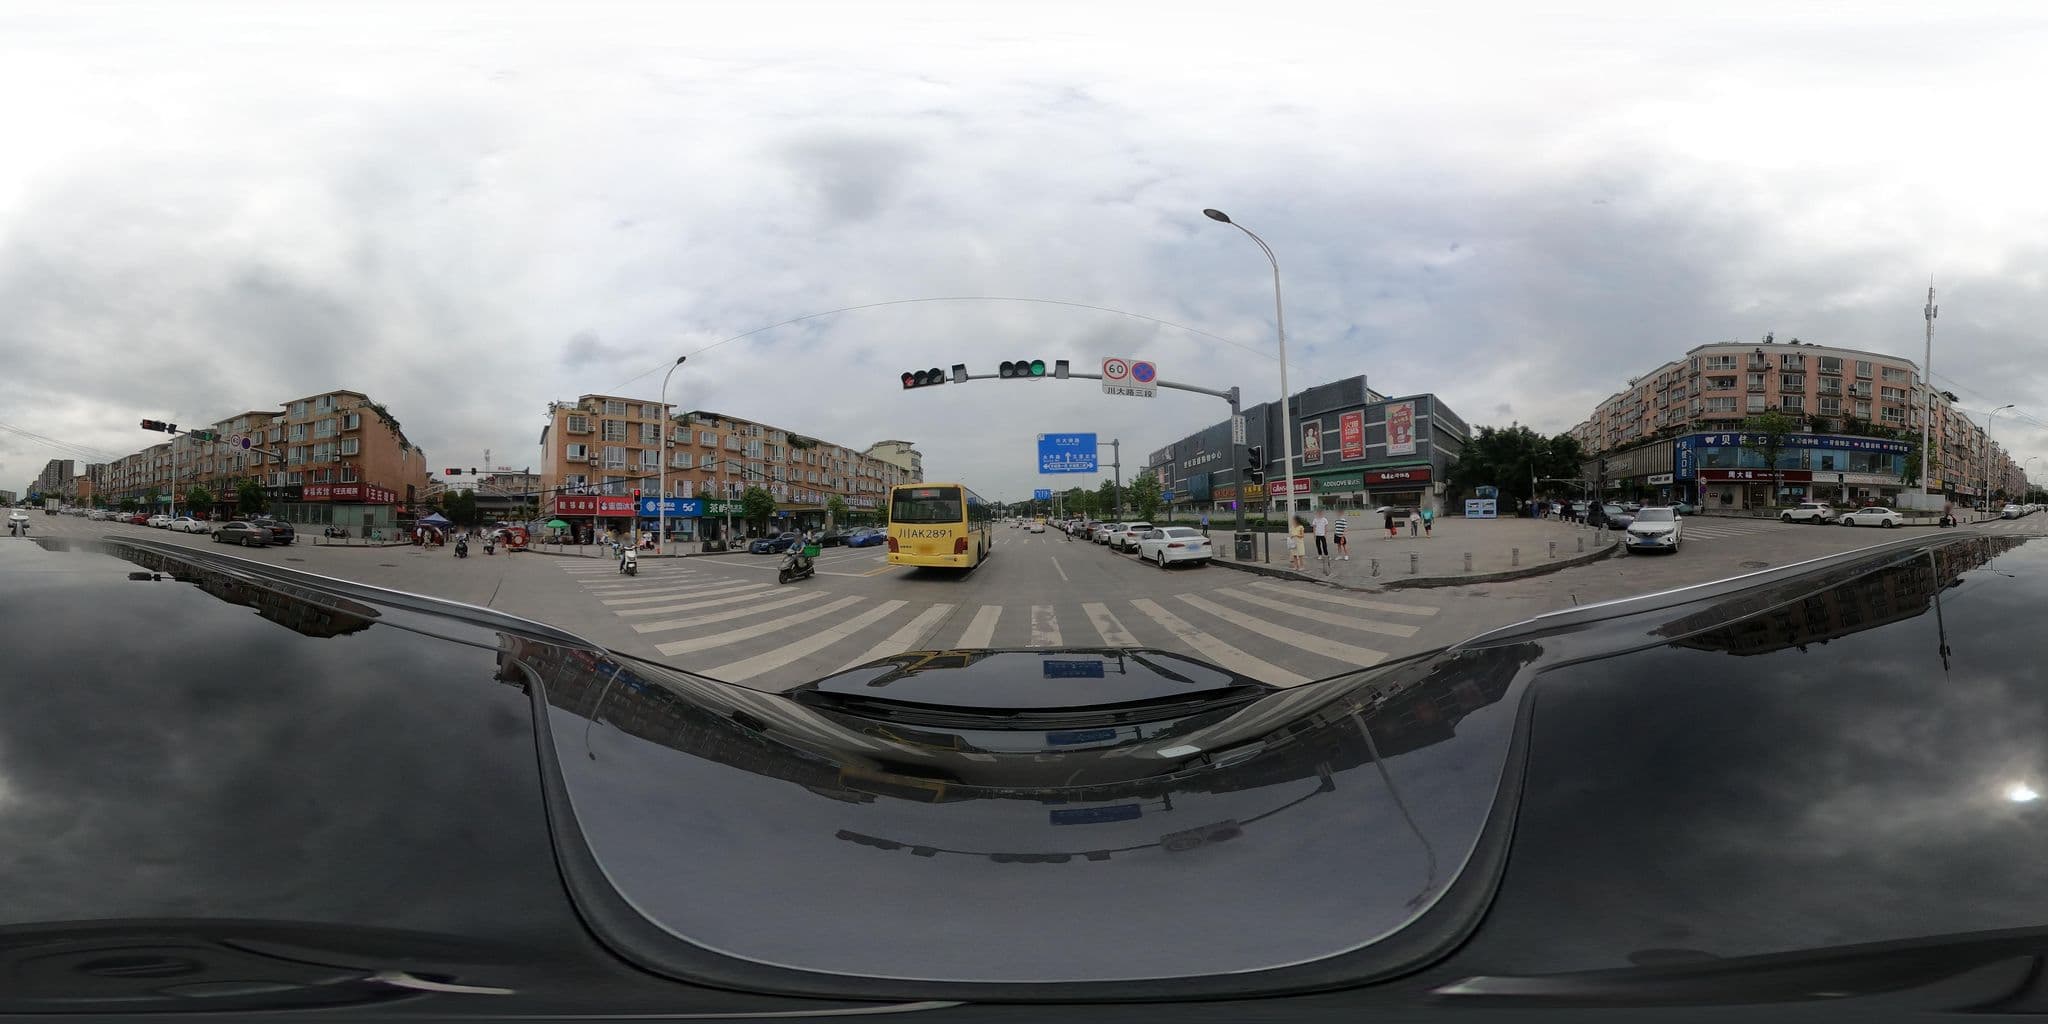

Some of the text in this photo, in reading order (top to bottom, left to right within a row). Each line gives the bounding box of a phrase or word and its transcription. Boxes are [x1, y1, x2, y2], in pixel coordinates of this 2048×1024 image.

[1109, 364, 1123, 374] 60
[1107, 387, 1153, 398] 川大路三段
[1728, 471, 1753, 479] 周大福
[682, 503, 694, 512] 5G
